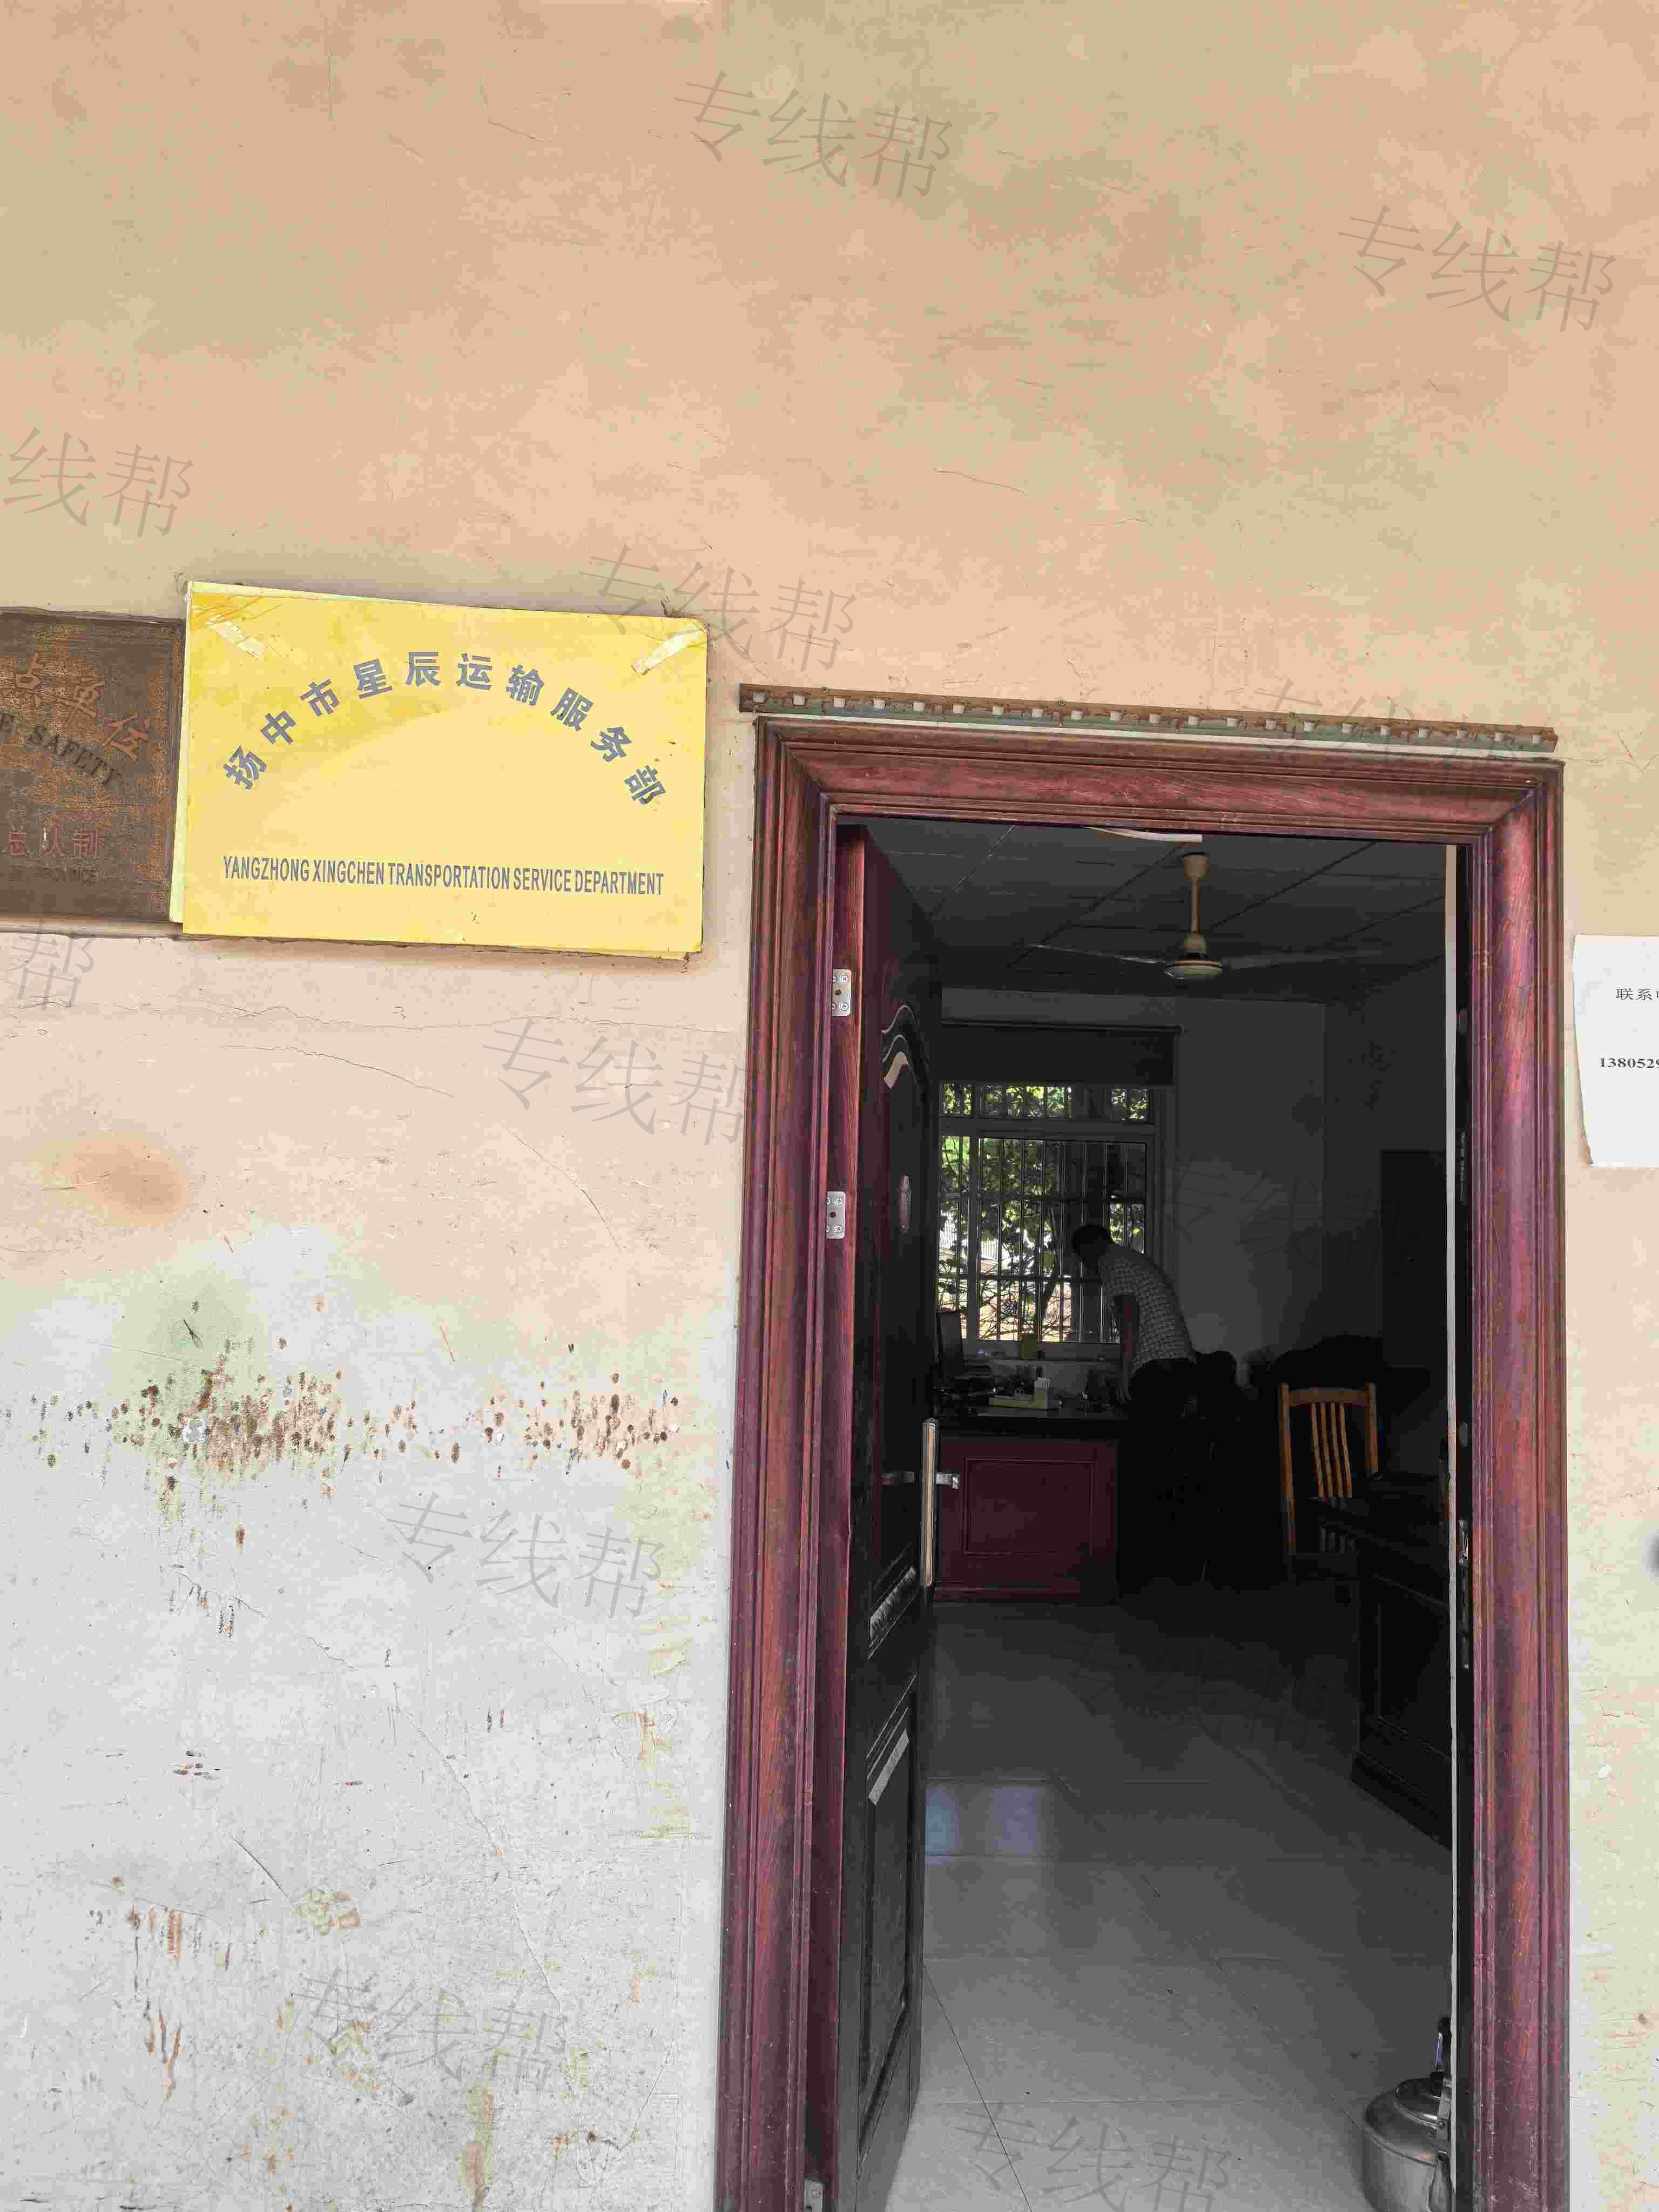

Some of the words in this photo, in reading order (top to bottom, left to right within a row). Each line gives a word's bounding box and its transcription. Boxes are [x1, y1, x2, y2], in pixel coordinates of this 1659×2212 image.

[222, 651, 667, 805] 扬中市星辰运输服务部
[27, 725, 122, 785] SAFETY
[223, 855, 309, 881] YANGZHONG
[313, 859, 385, 885] XINGCHEN
[388, 862, 510, 889] TRANSPORTATION
[513, 867, 571, 892] SERVICE
[575, 871, 664, 895] DEPARTMENT
[1616, 988, 1659, 1000] 联系
